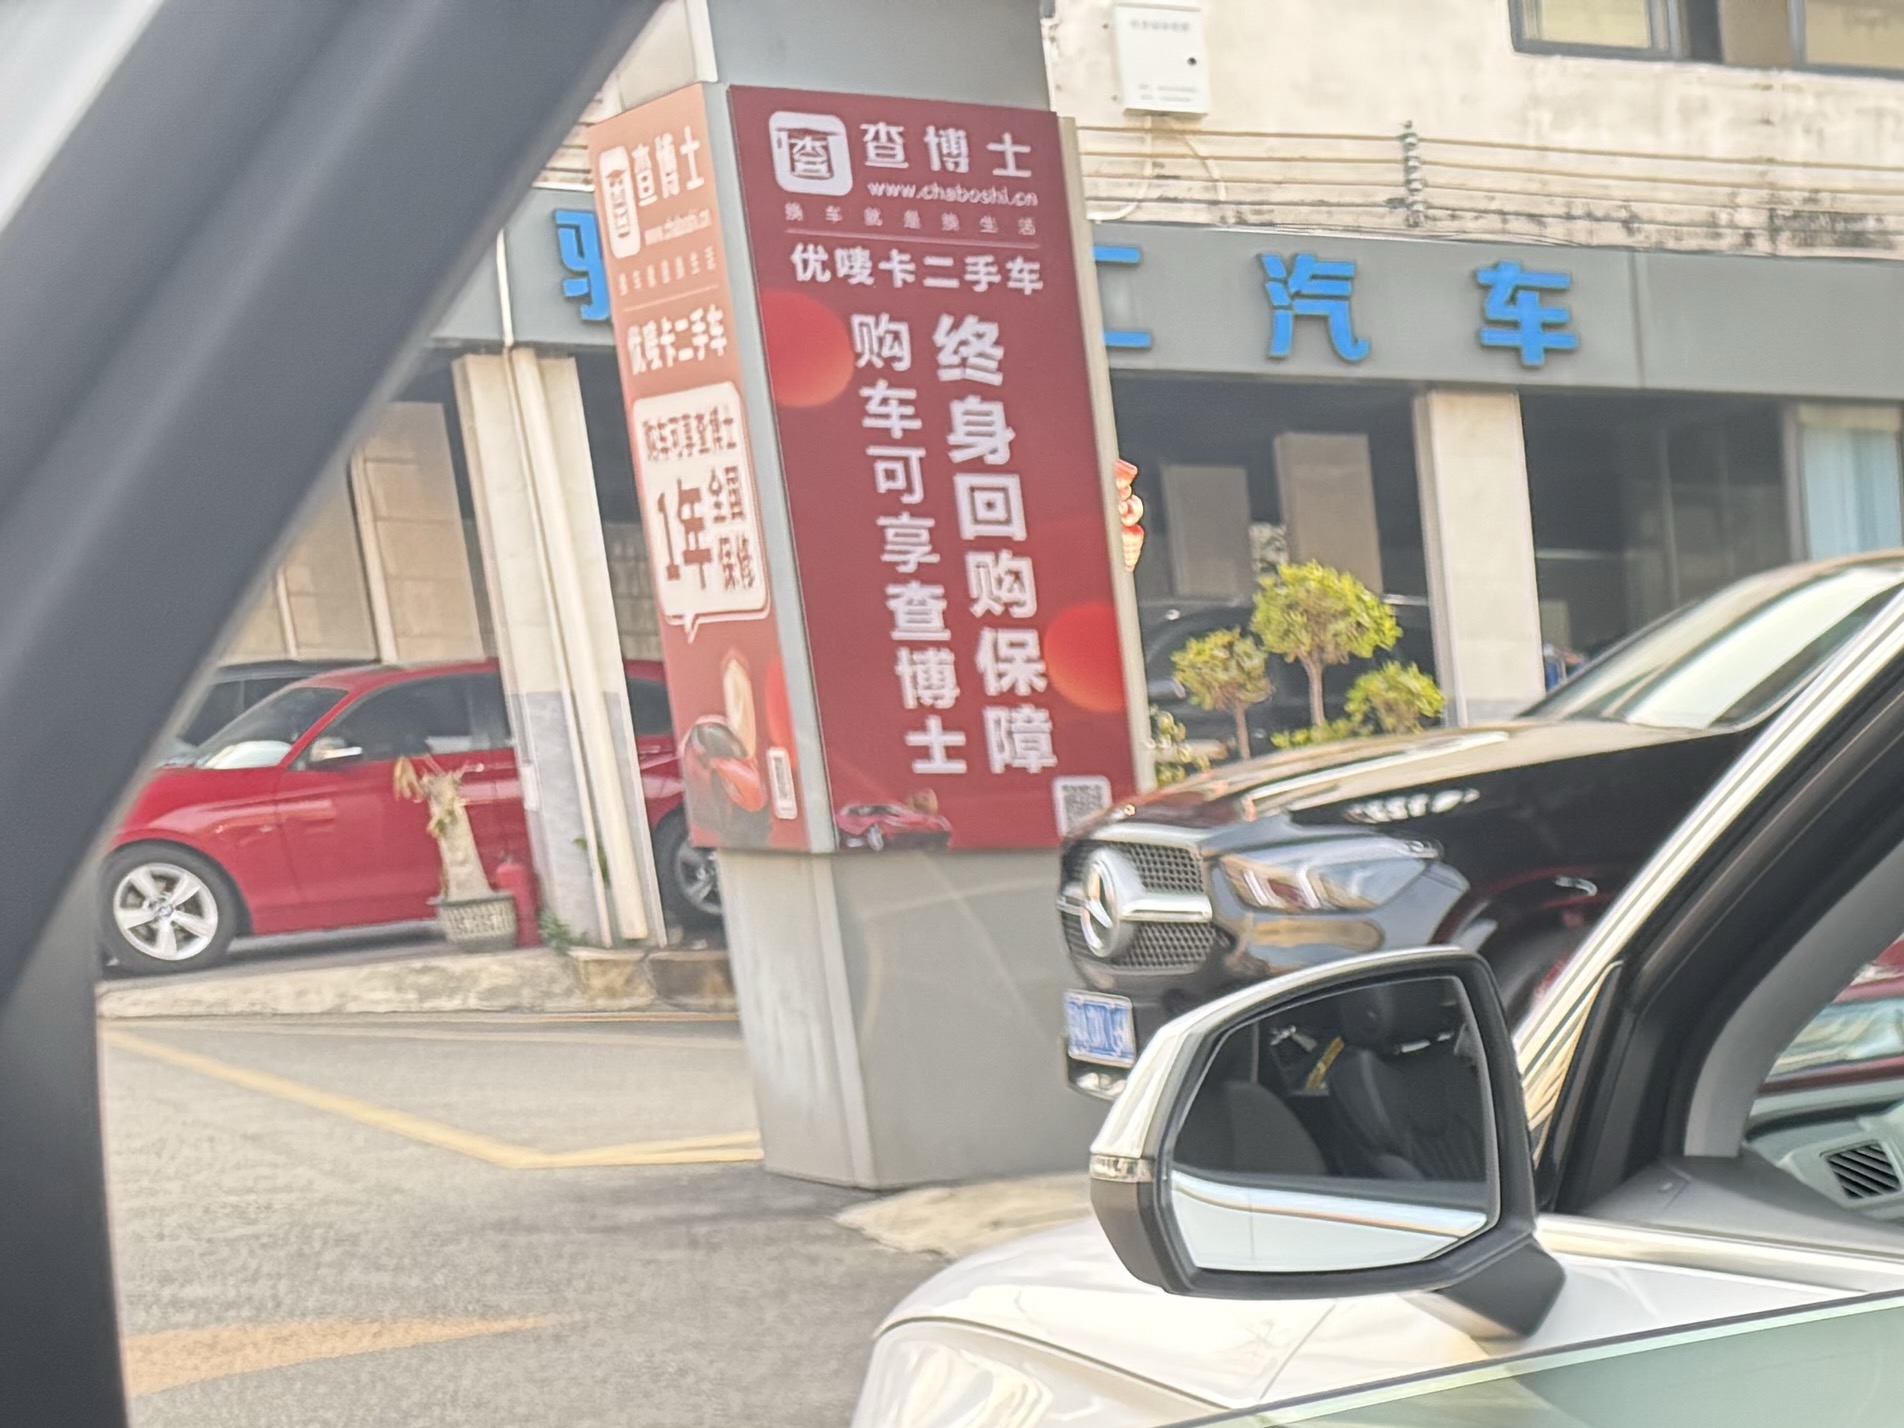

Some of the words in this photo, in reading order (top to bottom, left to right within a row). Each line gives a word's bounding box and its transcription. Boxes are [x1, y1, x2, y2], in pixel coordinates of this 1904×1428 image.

[860, 122, 1032, 178] 查博士
[657, 477, 713, 590] 1年
[850, 312, 967, 774] 购车可享查博士
[932, 313, 1058, 774] 终身回购保障
